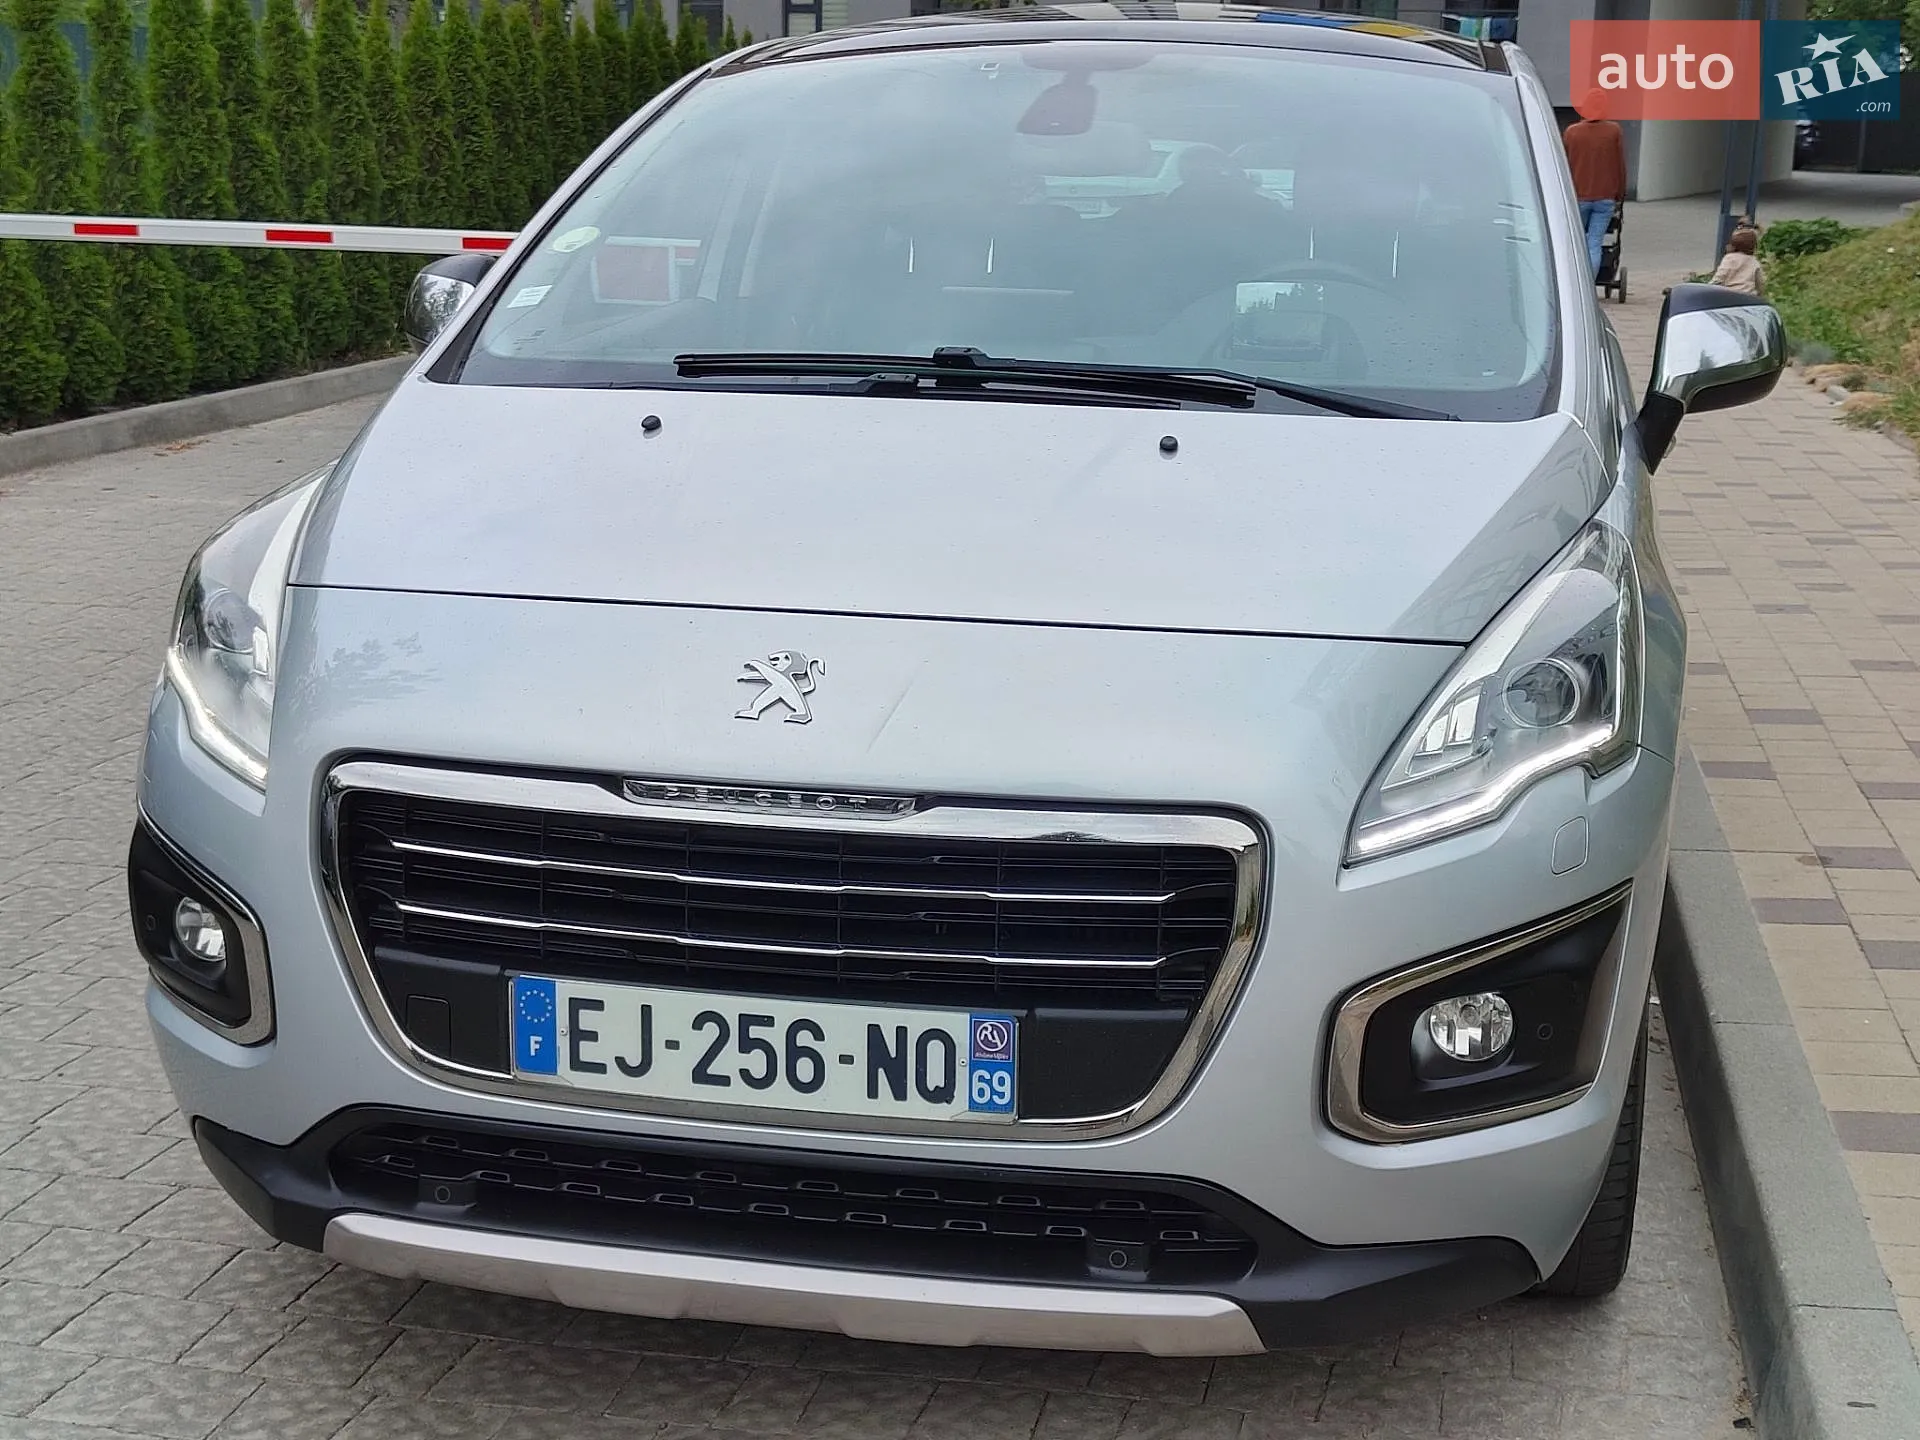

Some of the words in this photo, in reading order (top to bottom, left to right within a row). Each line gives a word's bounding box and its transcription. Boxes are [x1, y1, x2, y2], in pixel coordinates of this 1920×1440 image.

[664, 785, 867, 811] PEUGEOT
[529, 1036, 543, 1056] F
[568, 997, 957, 1104] EJ-256-NQ
[972, 1070, 1011, 1105] 69
